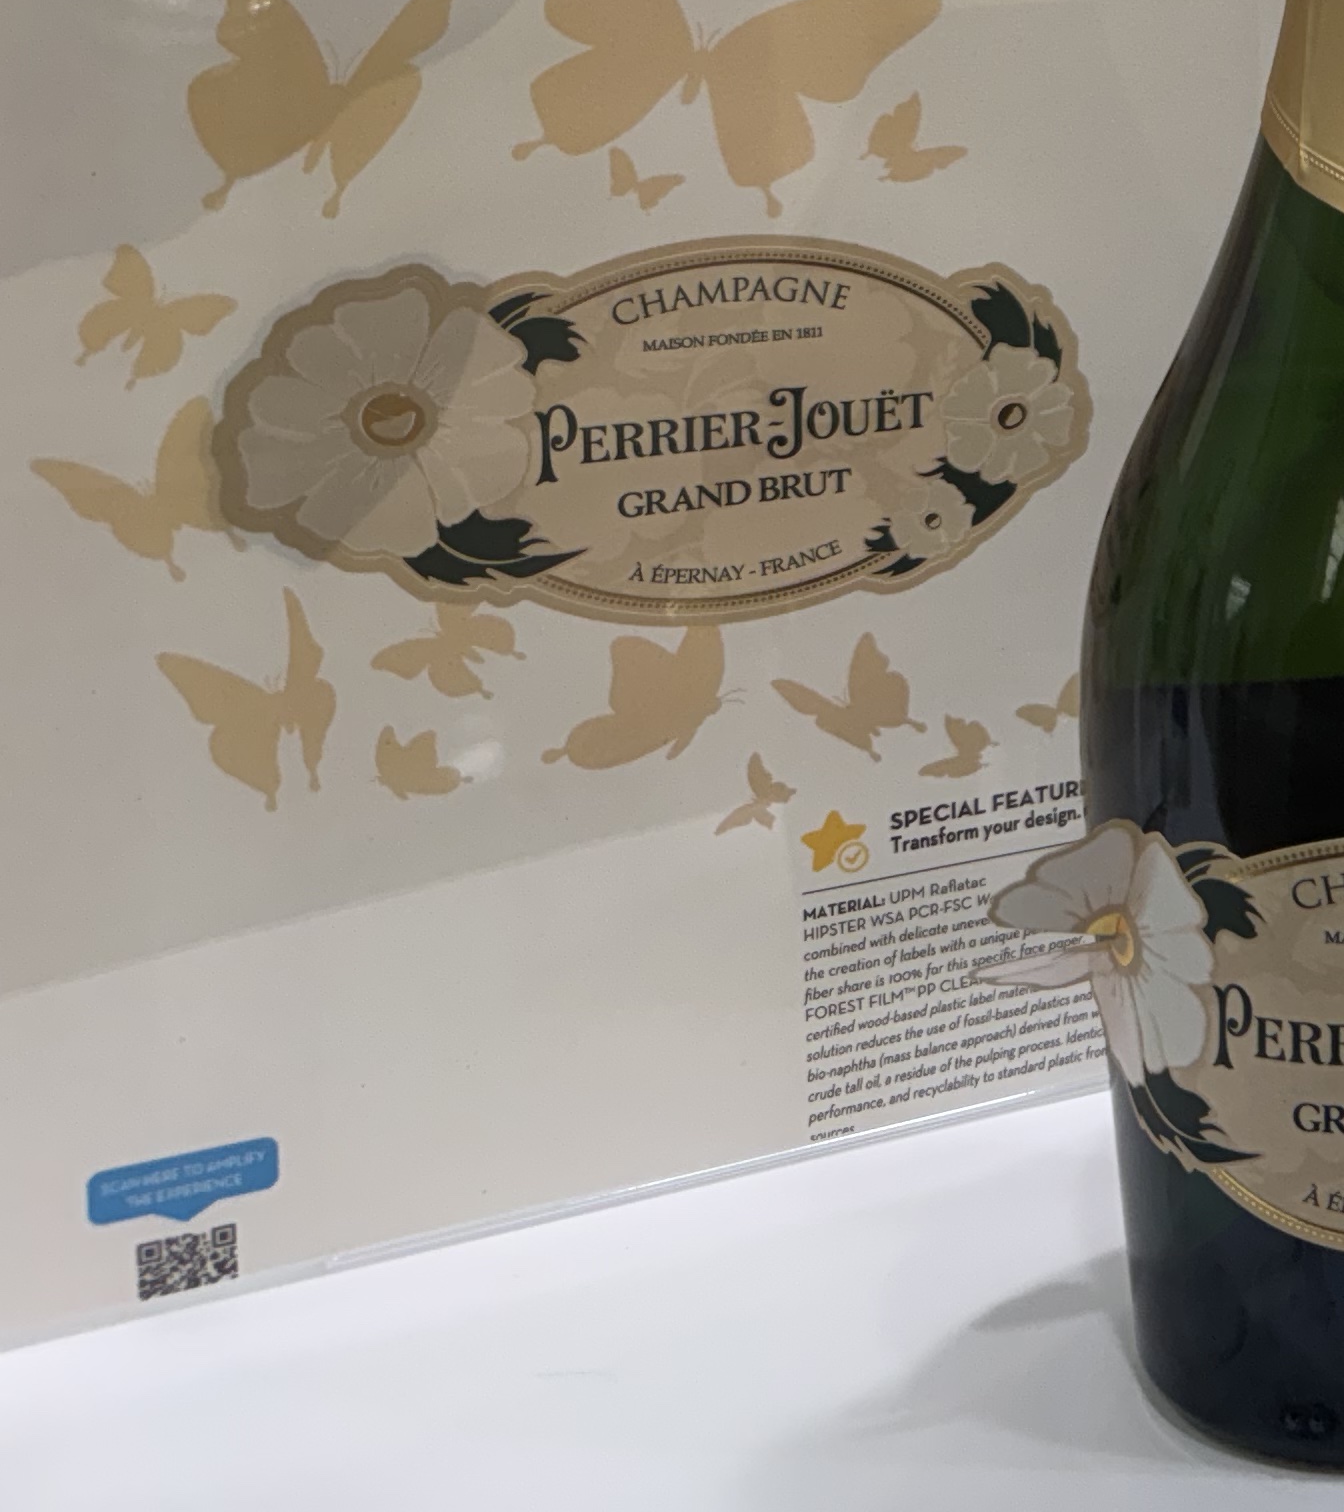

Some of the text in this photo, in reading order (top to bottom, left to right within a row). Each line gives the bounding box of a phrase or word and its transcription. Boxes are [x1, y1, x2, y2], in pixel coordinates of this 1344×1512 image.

[611, 275, 852, 326] CHAMPAGNE
[642, 326, 823, 352] MAISON FONDÉE EN 1811
[534, 385, 935, 487] PERRIER-JOUËT
[617, 467, 853, 518] GRAND BRUT
[629, 539, 843, 585] À ÉPERNAY FRANCE
[890, 798, 987, 831] SPECIAL
[890, 807, 1081, 854] Transform your design.
[803, 877, 987, 921] MATERIAL: UPM Raflatac
[803, 896, 973, 942] HIPSTER WSA PCR-FSC
[803, 915, 992, 962] combined with delicate uneve
[804, 967, 825, 982] the
[828, 957, 881, 977] creation
[884, 949, 897, 968] of
[900, 943, 937, 963] labels
[940, 937, 966, 955] with
[968, 936, 977, 946] a
[980, 928, 1021, 946] unique
[804, 987, 835, 1006] fiber
[837, 977, 873, 996] share
[875, 974, 885, 988] is
[889, 968, 923, 985] 100%
[924, 962, 944, 981] for
[947, 957, 968, 974] this
[972, 945, 1016, 969] specific
[1019, 941, 1046, 961] face
[805, 997, 865, 1022] FOREST
[917, 981, 936, 998] PP
[940, 974, 984, 993] CLEA
[806, 988, 997, 1043] certified wood-based plastic label
[806, 1044, 853, 1063] solution
[856, 1033, 902, 1053] reduces
[905, 1025, 924, 1040] the
[926, 1022, 946, 1036] use
[949, 1014, 962, 1031] of
[963, 1001, 1029, 1029] fossil-based
[1030, 994, 1070, 1017] plastics
[807, 1056, 876, 1083] bio-naphtha
[879, 1050, 911, 1069] (mass
[915, 1040, 958, 1059] balance
[960, 1023, 1017, 1050] approach)
[1019, 1014, 1061, 1036] derived
[1063, 1010, 1088, 1029] from
[808, 1083, 842, 1104] crude
[845, 1077, 863, 1095] tall
[885, 1076, 892, 1086] a
[894, 1063, 937, 1083] residue
[939, 1057, 953, 1073] of
[954, 1055, 973, 1070] the
[975, 1048, 1016, 1070] pulping
[1018, 1037, 1063, 1060] process.
[808, 1050, 1083, 1128] performance, and recyclability to standard plastic
[1303, 1184, 1321, 1209] À
